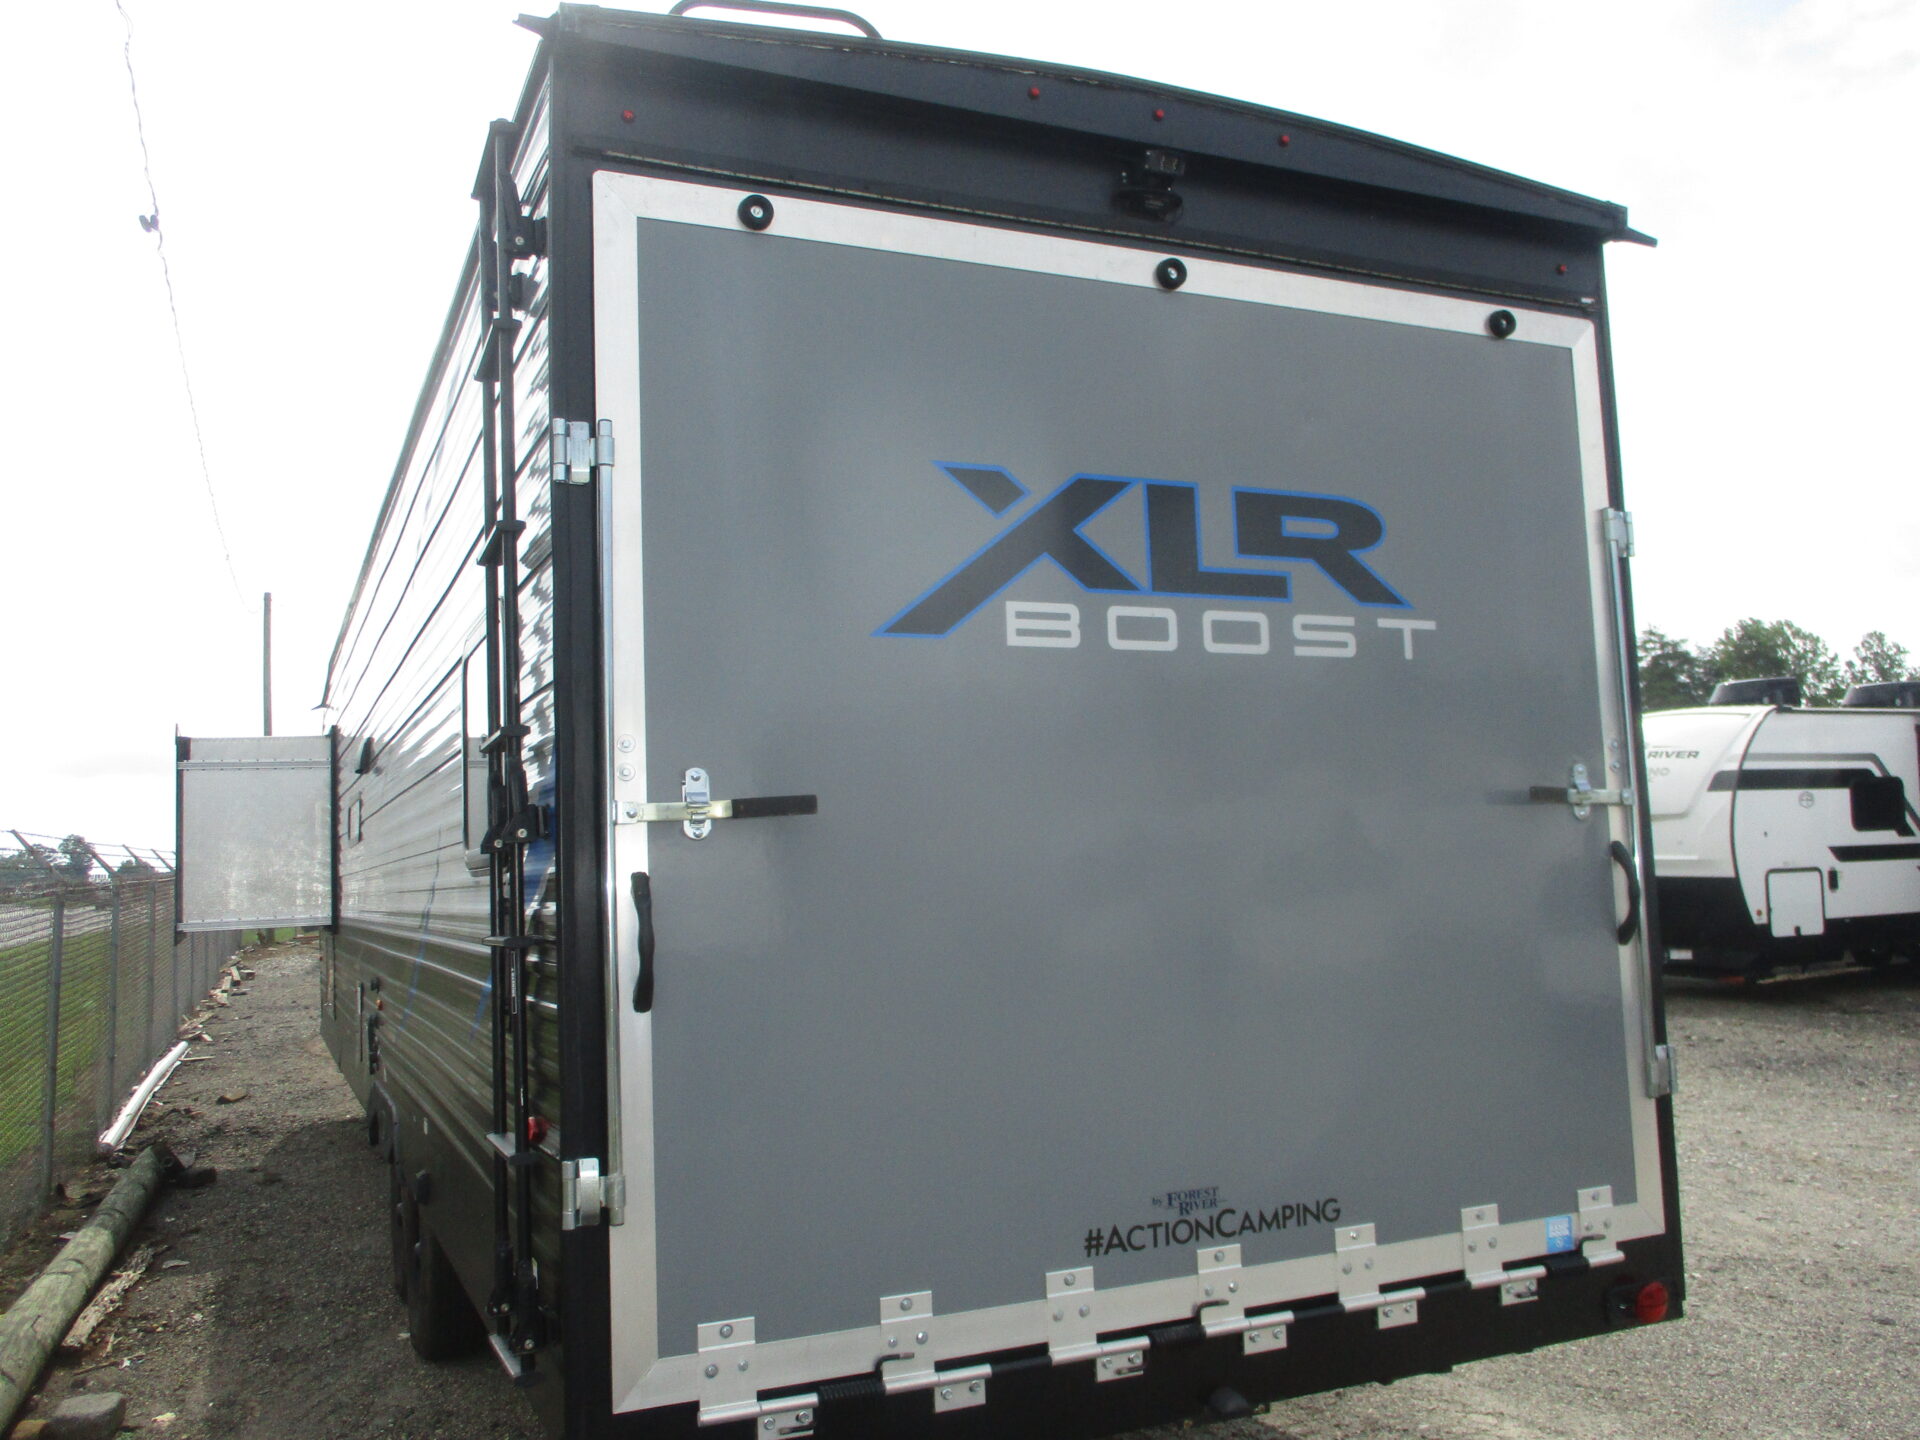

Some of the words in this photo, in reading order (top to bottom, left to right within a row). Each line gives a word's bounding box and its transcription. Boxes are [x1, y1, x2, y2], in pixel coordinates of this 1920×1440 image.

[870, 460, 1414, 638] XLR
[1005, 601, 1437, 660] BOOST
[1647, 750, 1700, 759] RIVER
[1166, 1186, 1219, 1207] FOREST
[1179, 1198, 1217, 1216] RIVER
